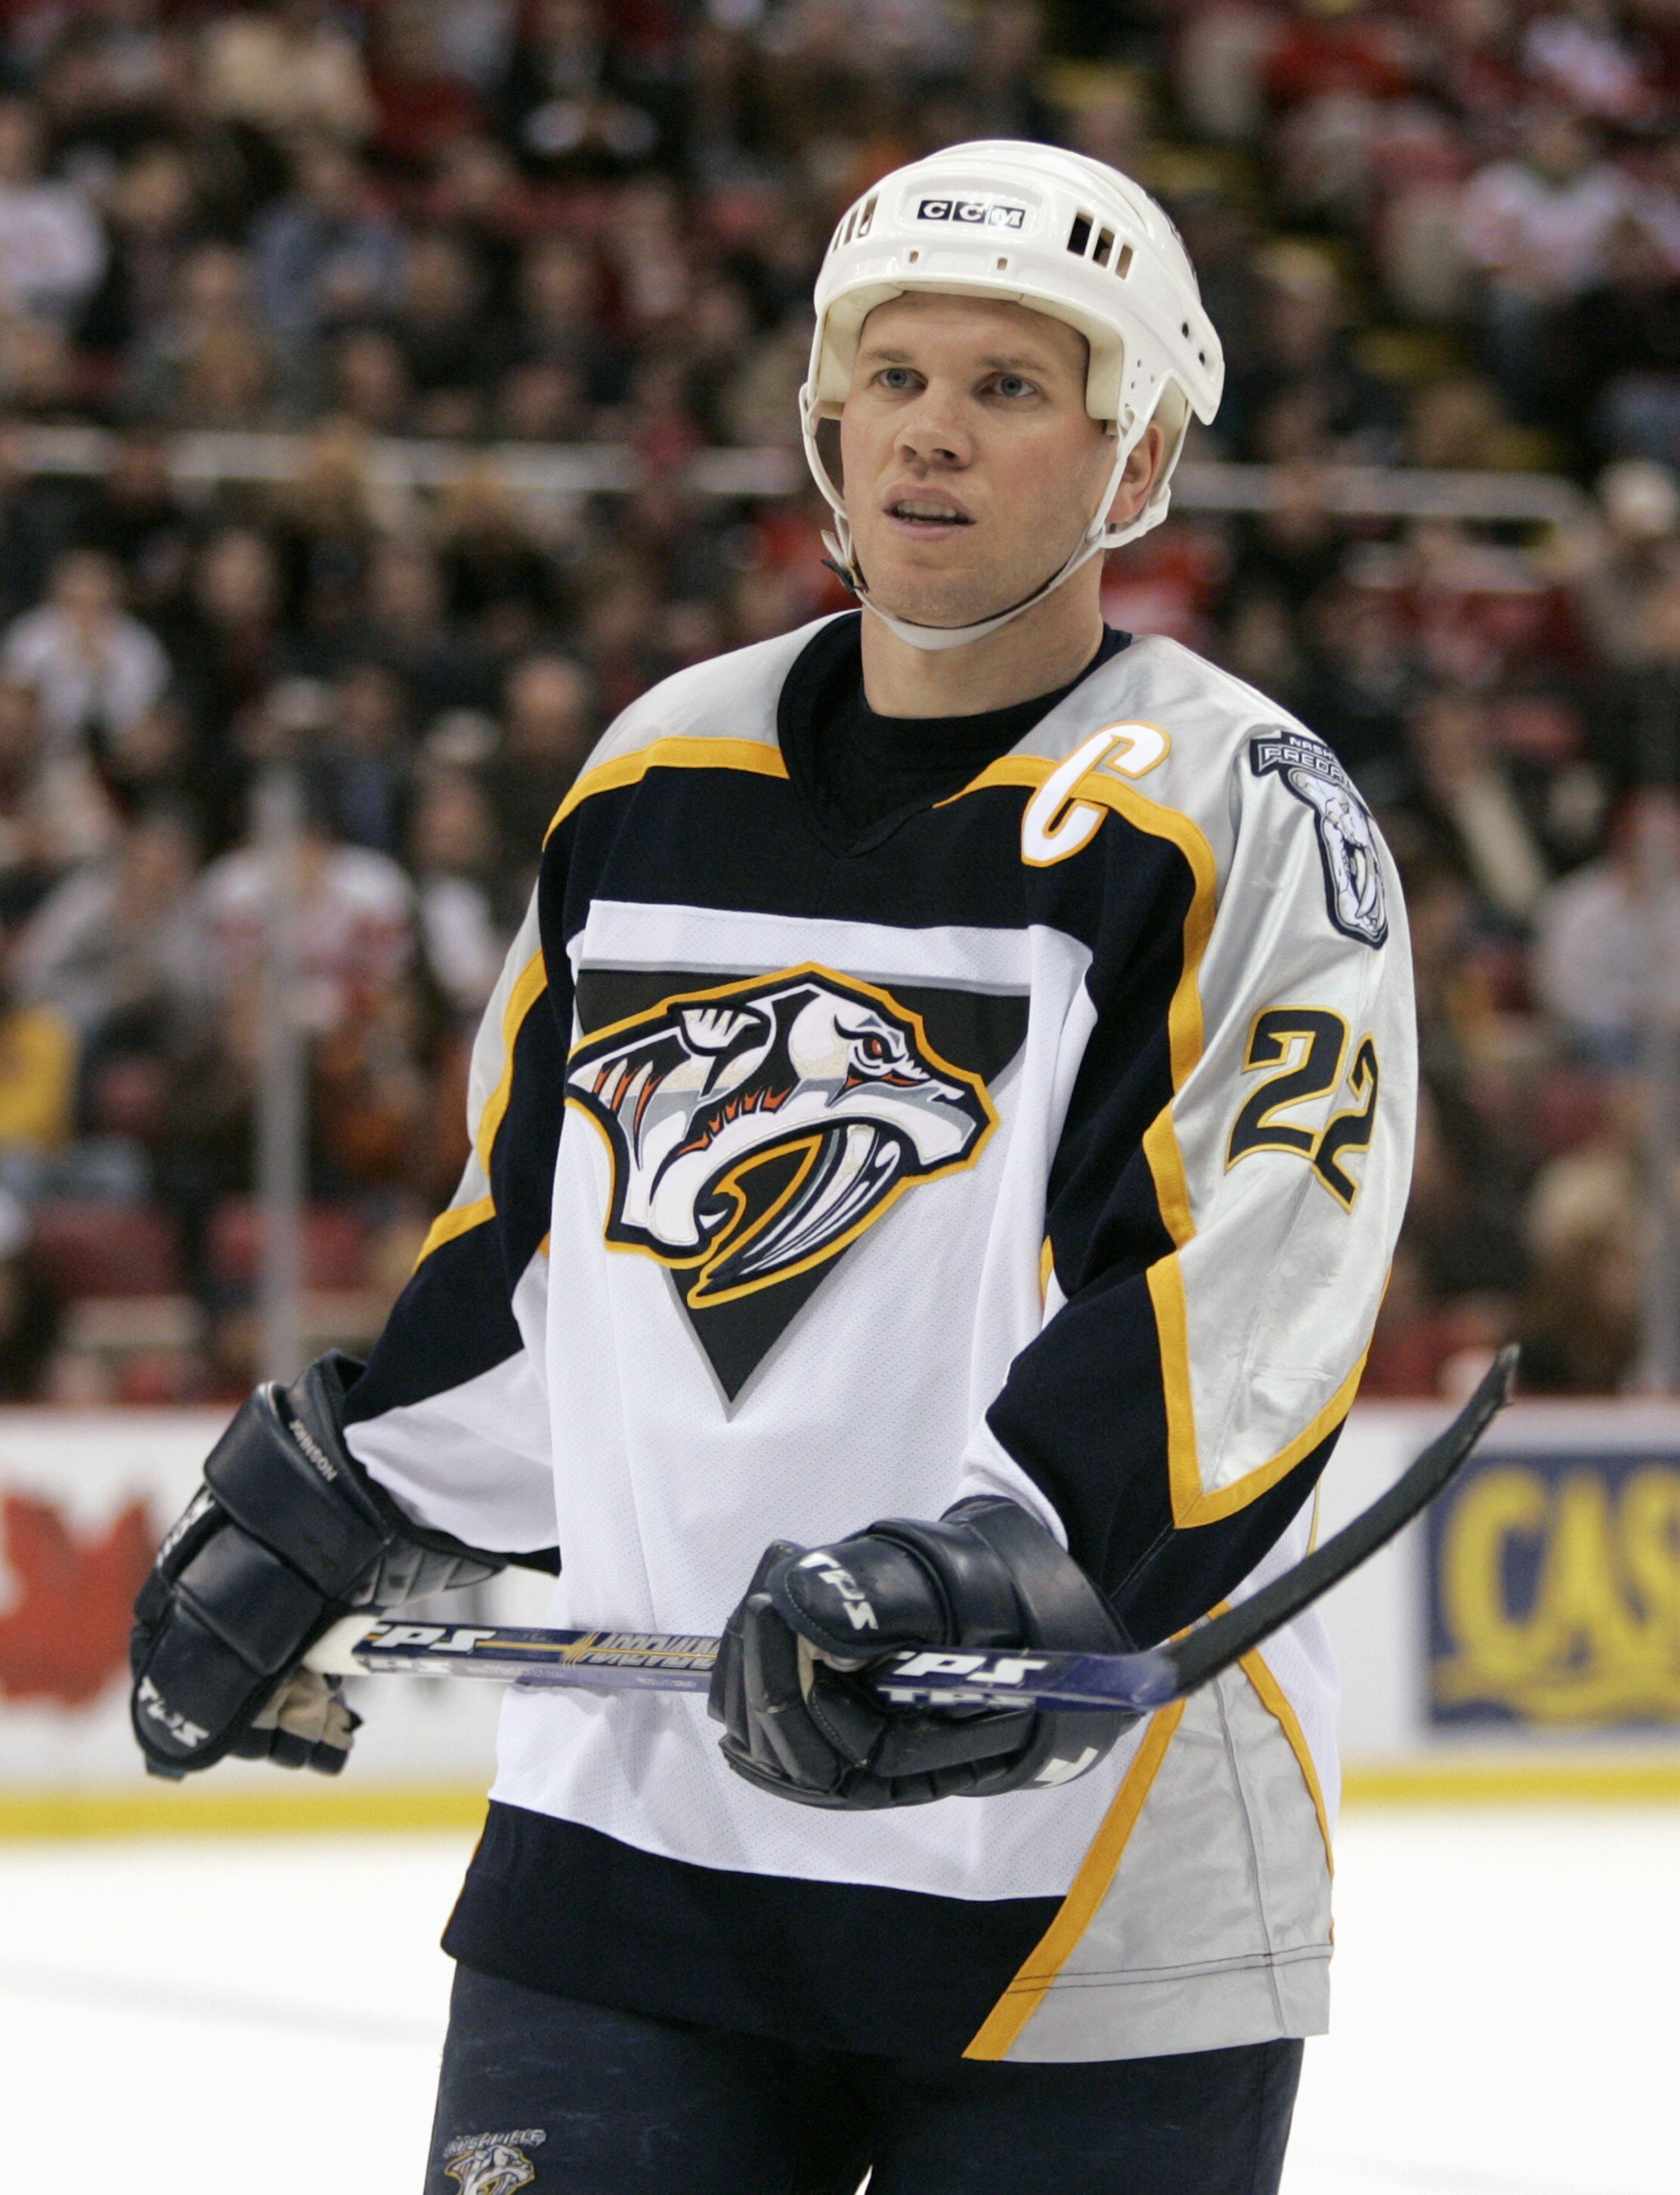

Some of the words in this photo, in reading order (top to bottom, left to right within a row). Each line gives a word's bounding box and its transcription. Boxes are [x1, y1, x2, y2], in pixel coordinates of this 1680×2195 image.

[917, 200, 1026, 228] CCM
[1021, 720, 1171, 868] C
[1224, 1005, 1378, 1214] 22
